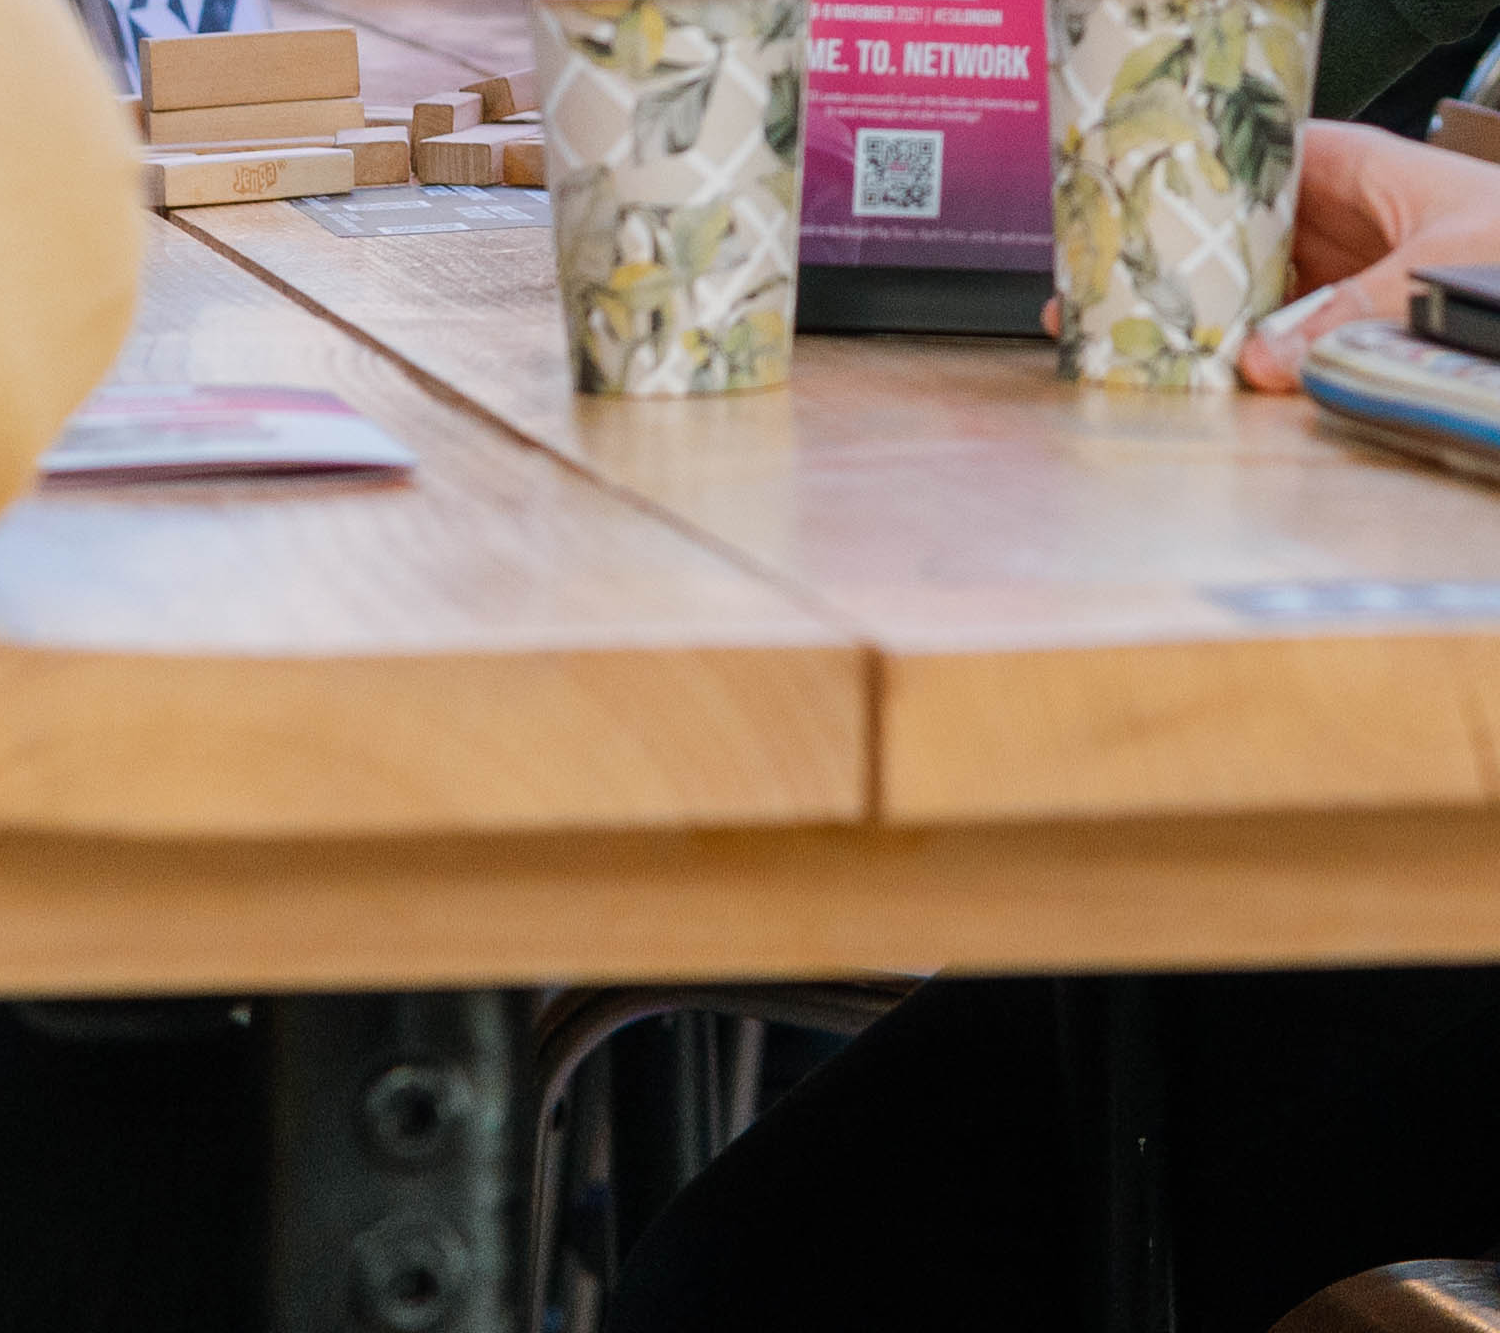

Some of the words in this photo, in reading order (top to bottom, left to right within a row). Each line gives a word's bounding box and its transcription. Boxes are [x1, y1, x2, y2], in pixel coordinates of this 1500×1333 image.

[807, 37, 848, 72] ME.
[855, 38, 897, 76] TO.
[903, 41, 1030, 80] NETWORK
[233, 161, 277, 195] Jenga
